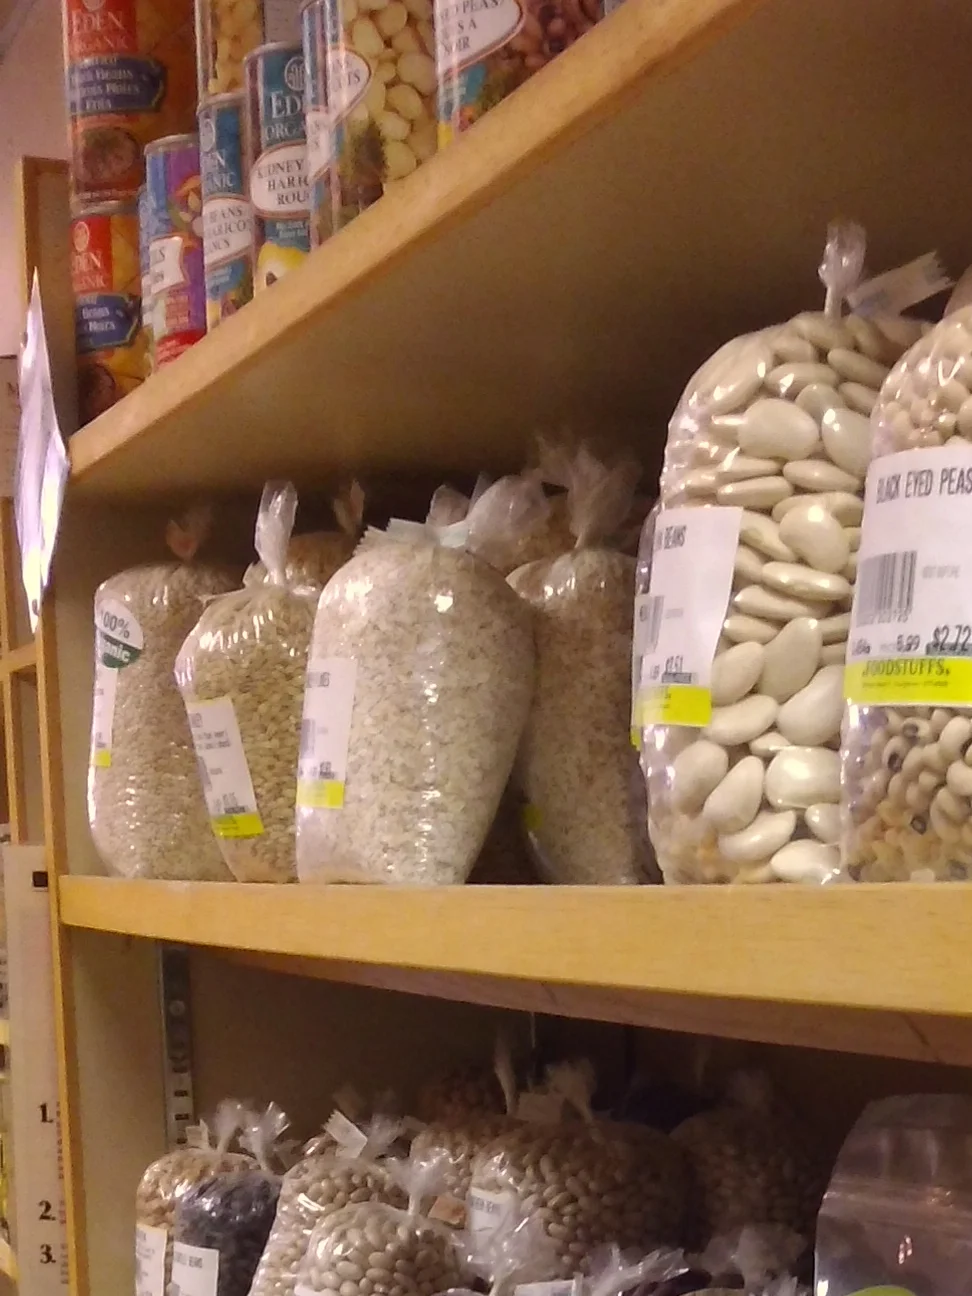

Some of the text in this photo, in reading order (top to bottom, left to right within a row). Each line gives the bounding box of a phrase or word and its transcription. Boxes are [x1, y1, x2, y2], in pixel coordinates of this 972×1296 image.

[270, 89, 307, 119] ED
[276, 190, 310, 206] ROU
[905, 468, 934, 499] EYED
[931, 624, 972, 652] $2.72
